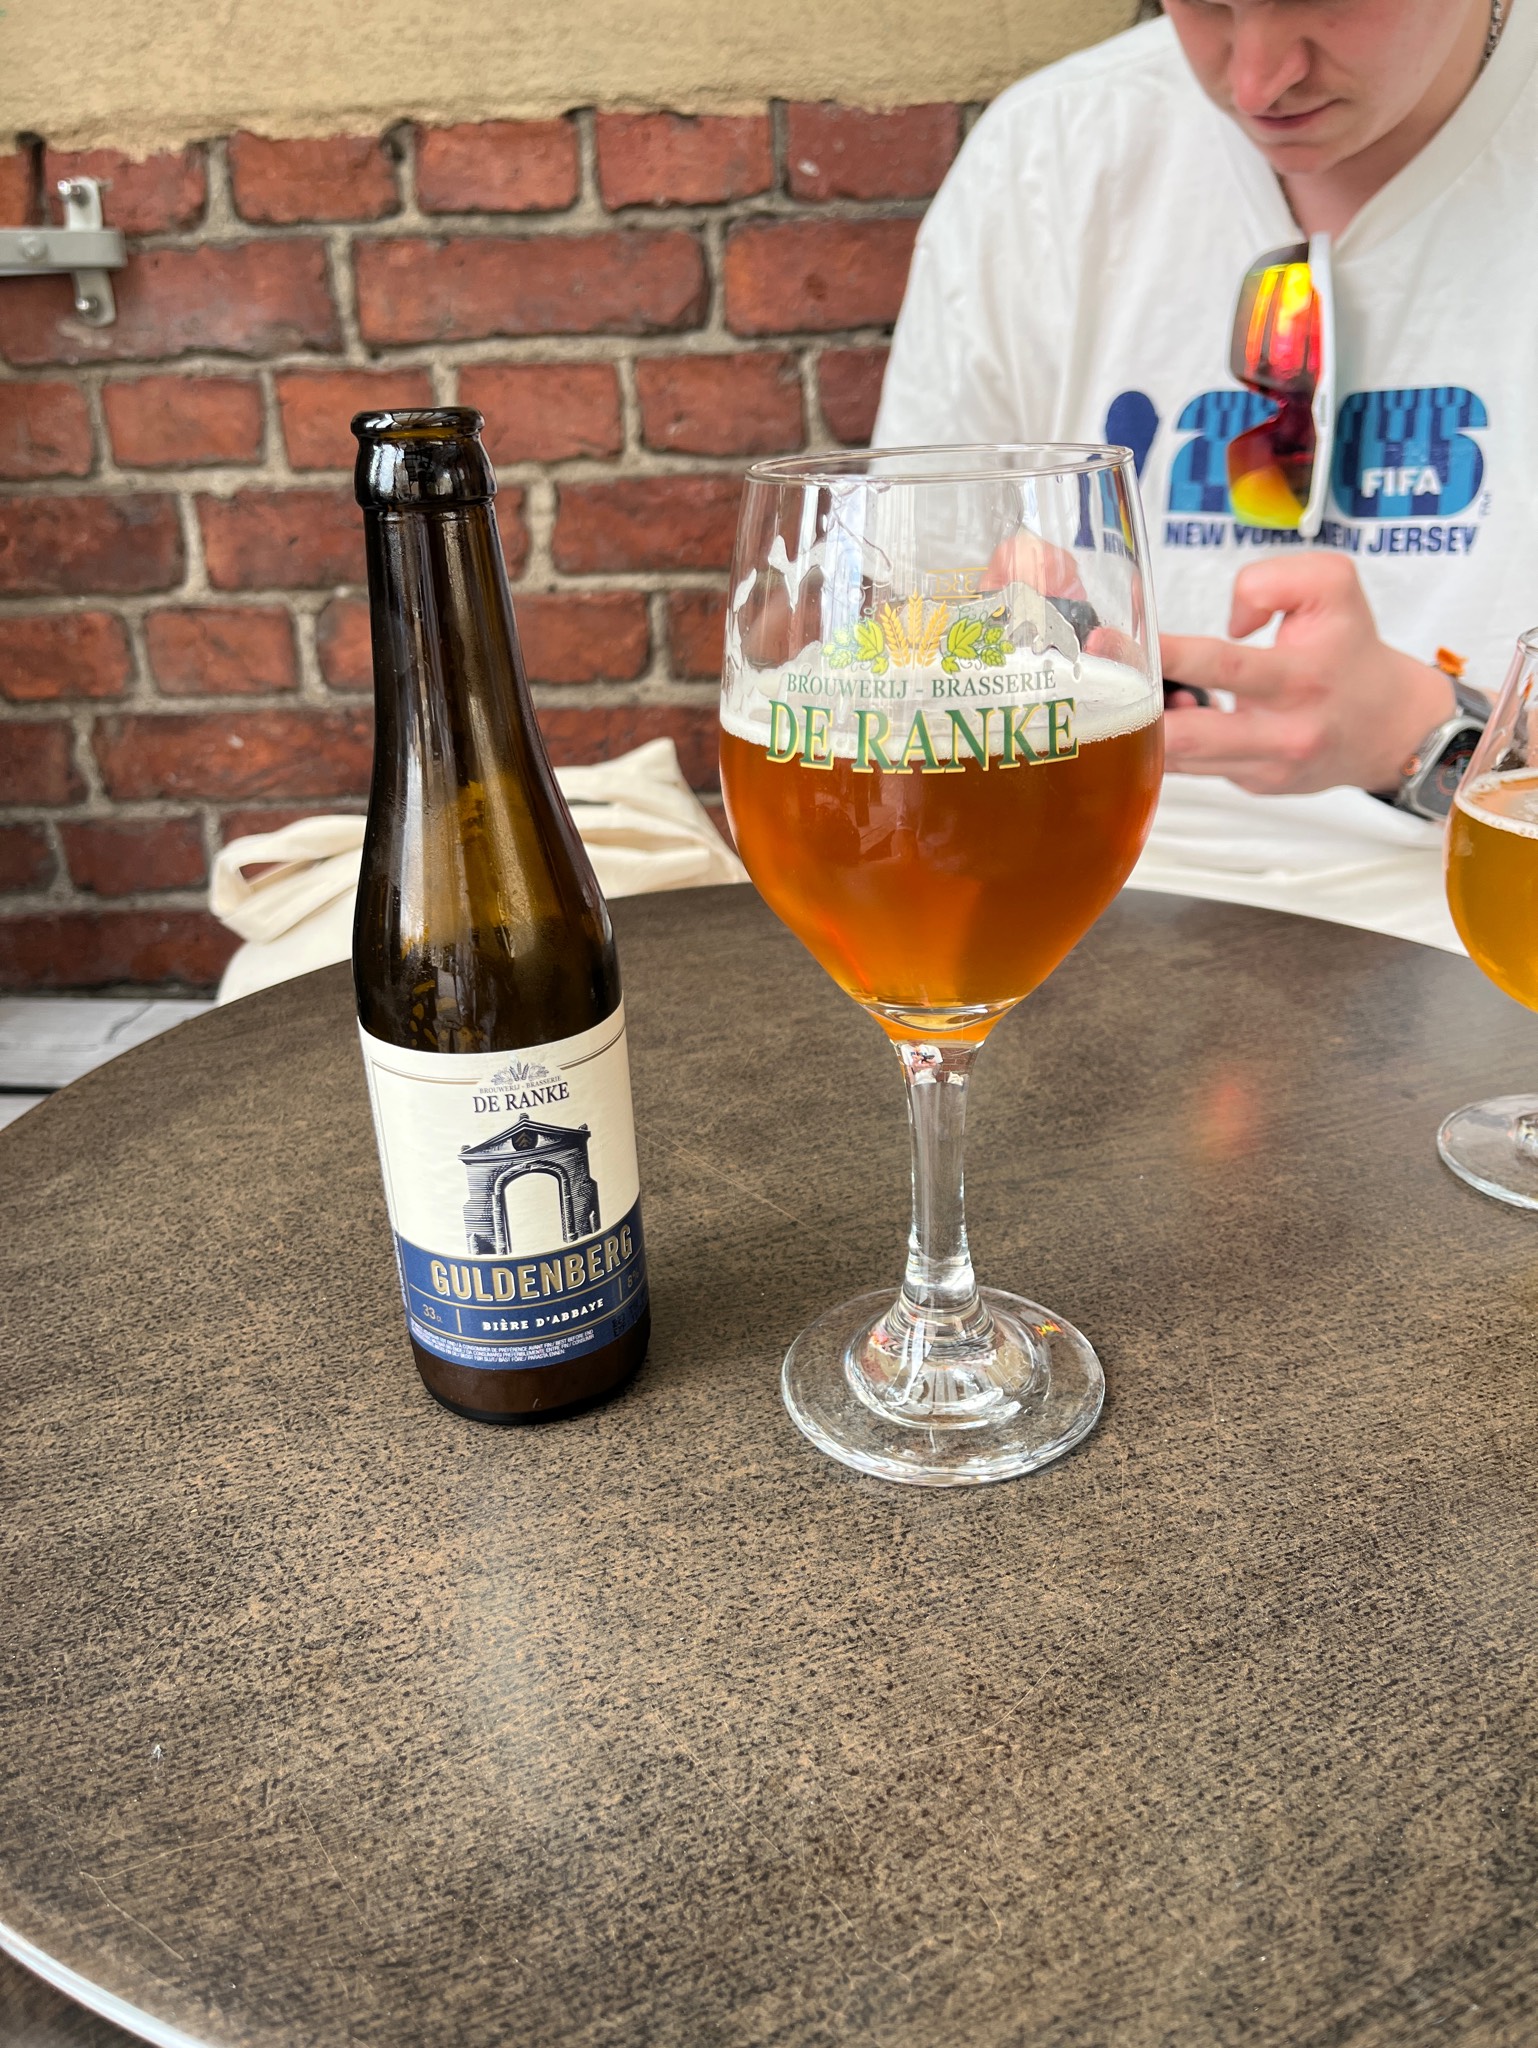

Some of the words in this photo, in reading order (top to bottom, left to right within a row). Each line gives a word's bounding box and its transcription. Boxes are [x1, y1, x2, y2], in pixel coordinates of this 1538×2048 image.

[1361, 465, 1442, 498] FIFA
[1166, 522, 1225, 549] NEW
[1368, 525, 1479, 554] JERSEY
[787, 673, 907, 698] BROUWERIJ
[932, 669, 1056, 698] BRASSERIE
[766, 700, 834, 770] DE
[851, 697, 1079, 774] RANKE
[472, 1095, 500, 1114] DE
[504, 1081, 571, 1112] RANKE
[526, 1075, 562, 1089] BRASSERIE
[430, 1224, 633, 1302] GULDENBERG
[482, 1318, 529, 1331] BIÈRE
[535, 1298, 604, 1328] D'ABBAYE
